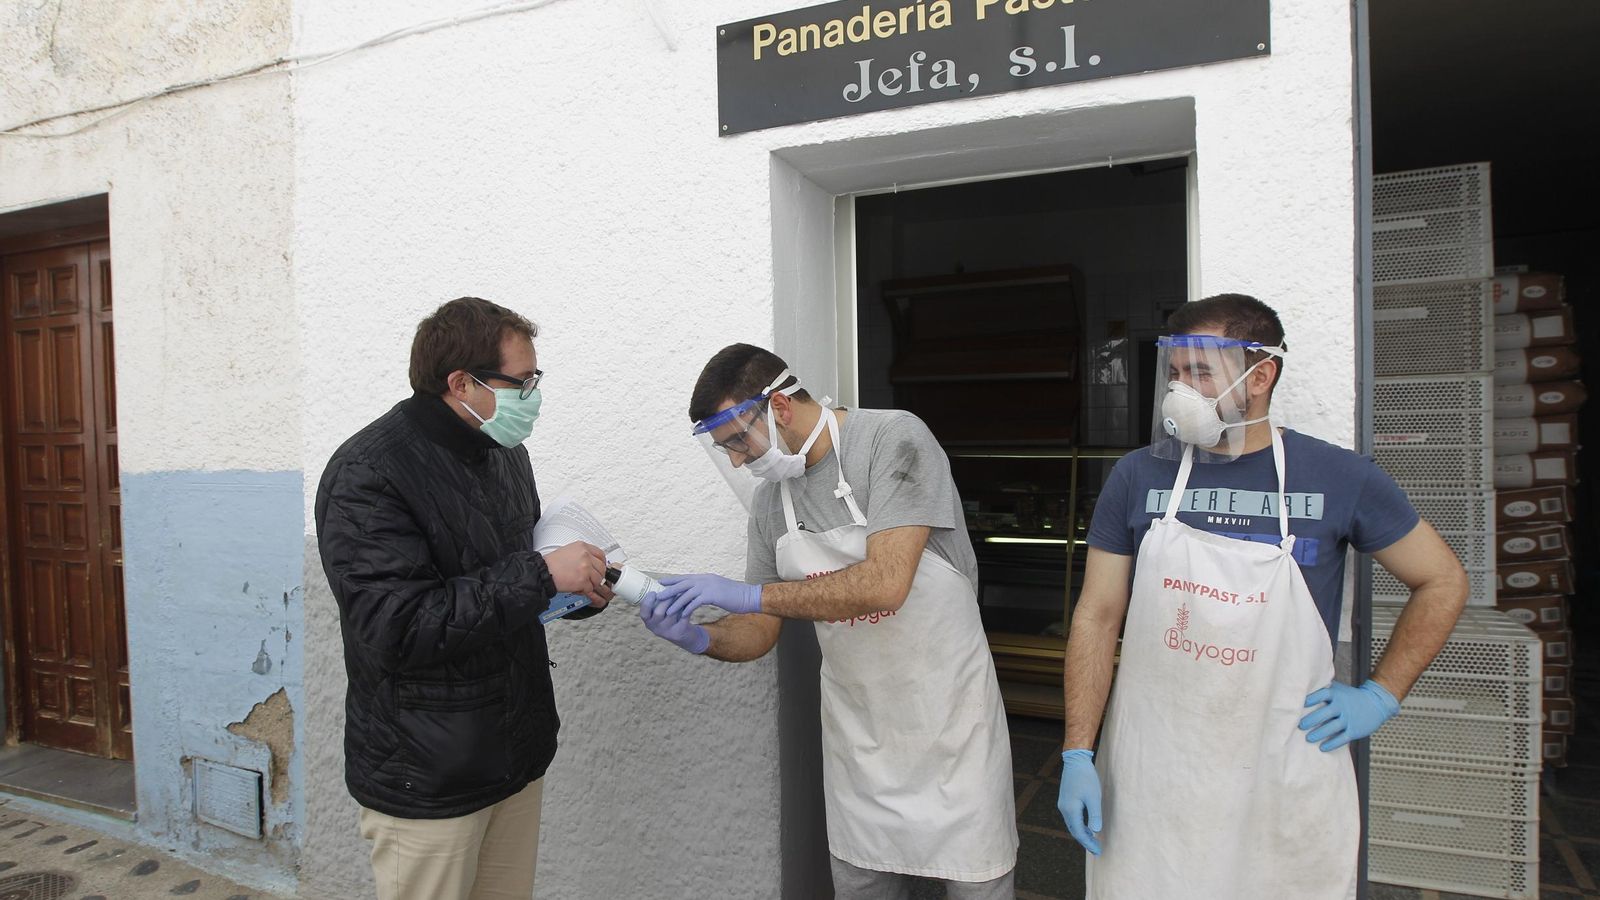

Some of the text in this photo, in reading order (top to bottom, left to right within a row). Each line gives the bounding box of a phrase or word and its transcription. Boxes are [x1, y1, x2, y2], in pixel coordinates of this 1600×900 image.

[842, 24, 1101, 103] Jefa, s.l.
[1157, 490, 1312, 517] TERE ARE
[1207, 515, 1251, 526] MMXVIII
[1165, 629, 1258, 665] Bayogar
